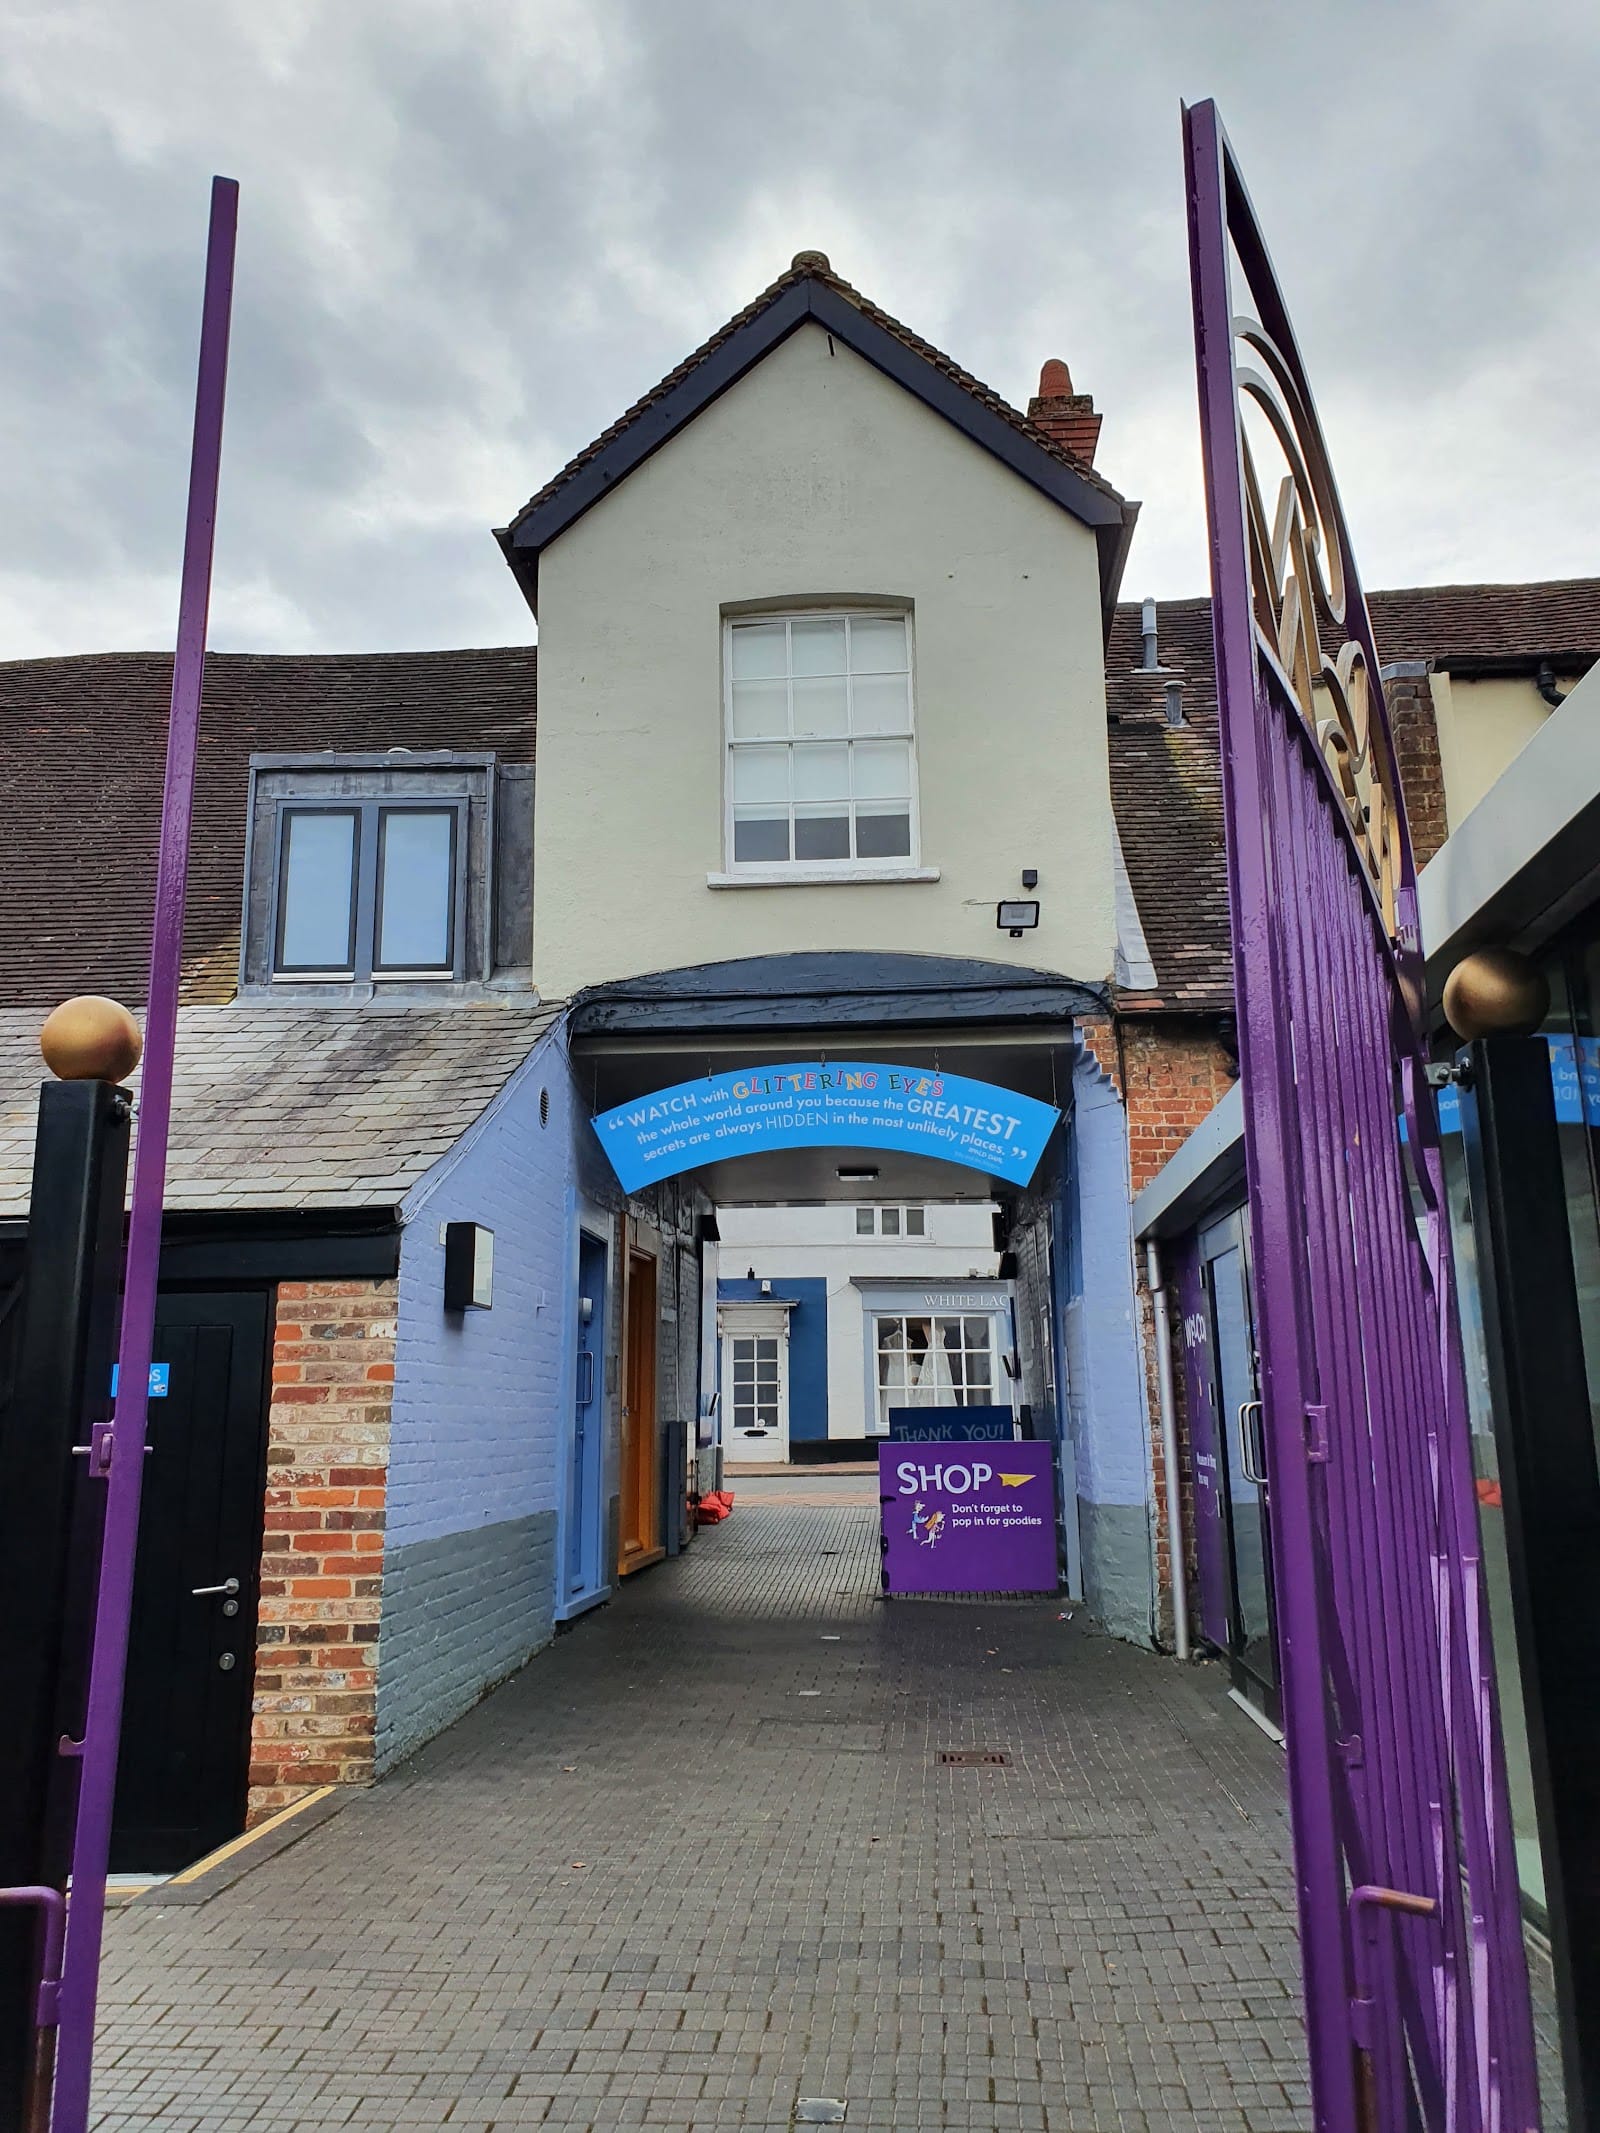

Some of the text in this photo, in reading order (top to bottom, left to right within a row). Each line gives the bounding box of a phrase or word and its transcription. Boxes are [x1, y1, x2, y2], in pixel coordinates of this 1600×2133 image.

[701, 1087, 729, 1105] with
[732, 1069, 879, 1099] GLITTERING
[888, 1072, 945, 1097] EYES
[637, 1094, 1022, 1145] the whole world around you because the GREATEST
[643, 1139, 687, 1162] secrets
[689, 1133, 711, 1146] are
[714, 1122, 763, 1139] always
[766, 1111, 829, 1130] HIDDEN
[832, 1112, 845, 1124] in
[848, 1111, 869, 1126] the
[872, 1114, 904, 1128] most
[906, 1119, 959, 1142] unlikely
[924, 1294, 976, 1307] WHITE
[894, 1423, 1005, 1442] THANK YOU!
[896, 1461, 993, 1495] SHOP
[952, 1503, 1023, 1518] Don't forget to
[952, 1516, 1043, 1529] pop in for goodies
